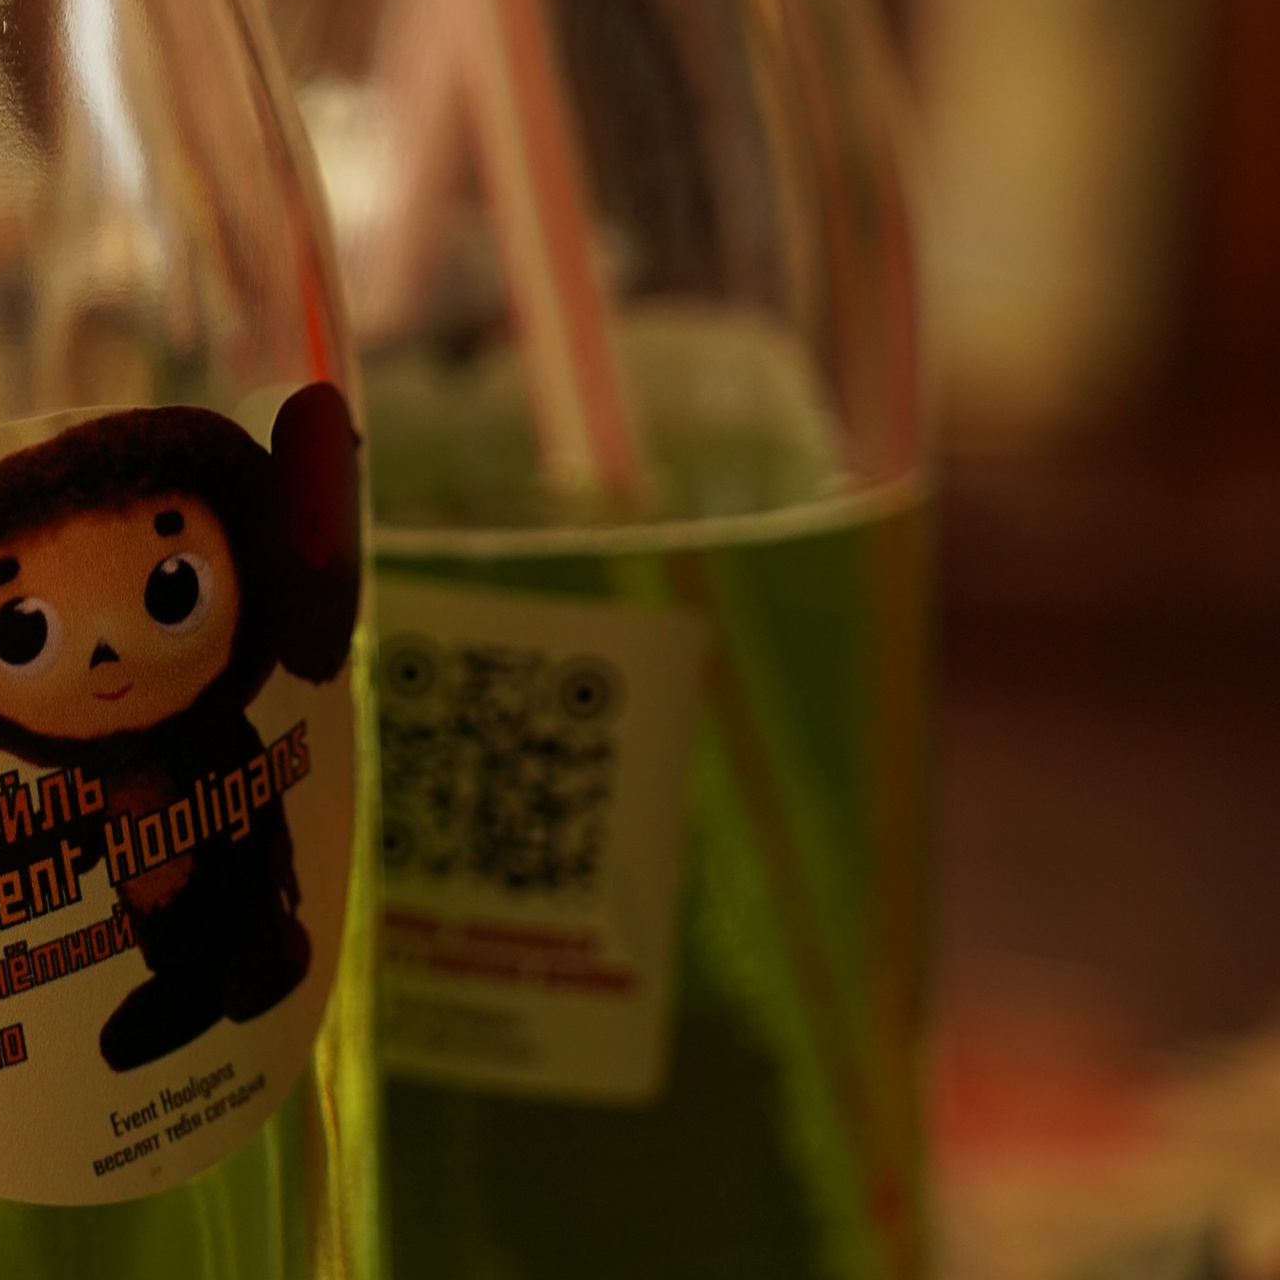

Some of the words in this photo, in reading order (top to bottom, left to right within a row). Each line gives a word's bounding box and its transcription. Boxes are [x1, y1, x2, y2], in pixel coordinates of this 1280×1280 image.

[103, 719, 310, 888] Hooligans
[109, 1102, 158, 1137] Event
[159, 1062, 235, 1112] Hooligans
[92, 1134, 160, 1177] веселят
[164, 1111, 203, 1143] тебя
